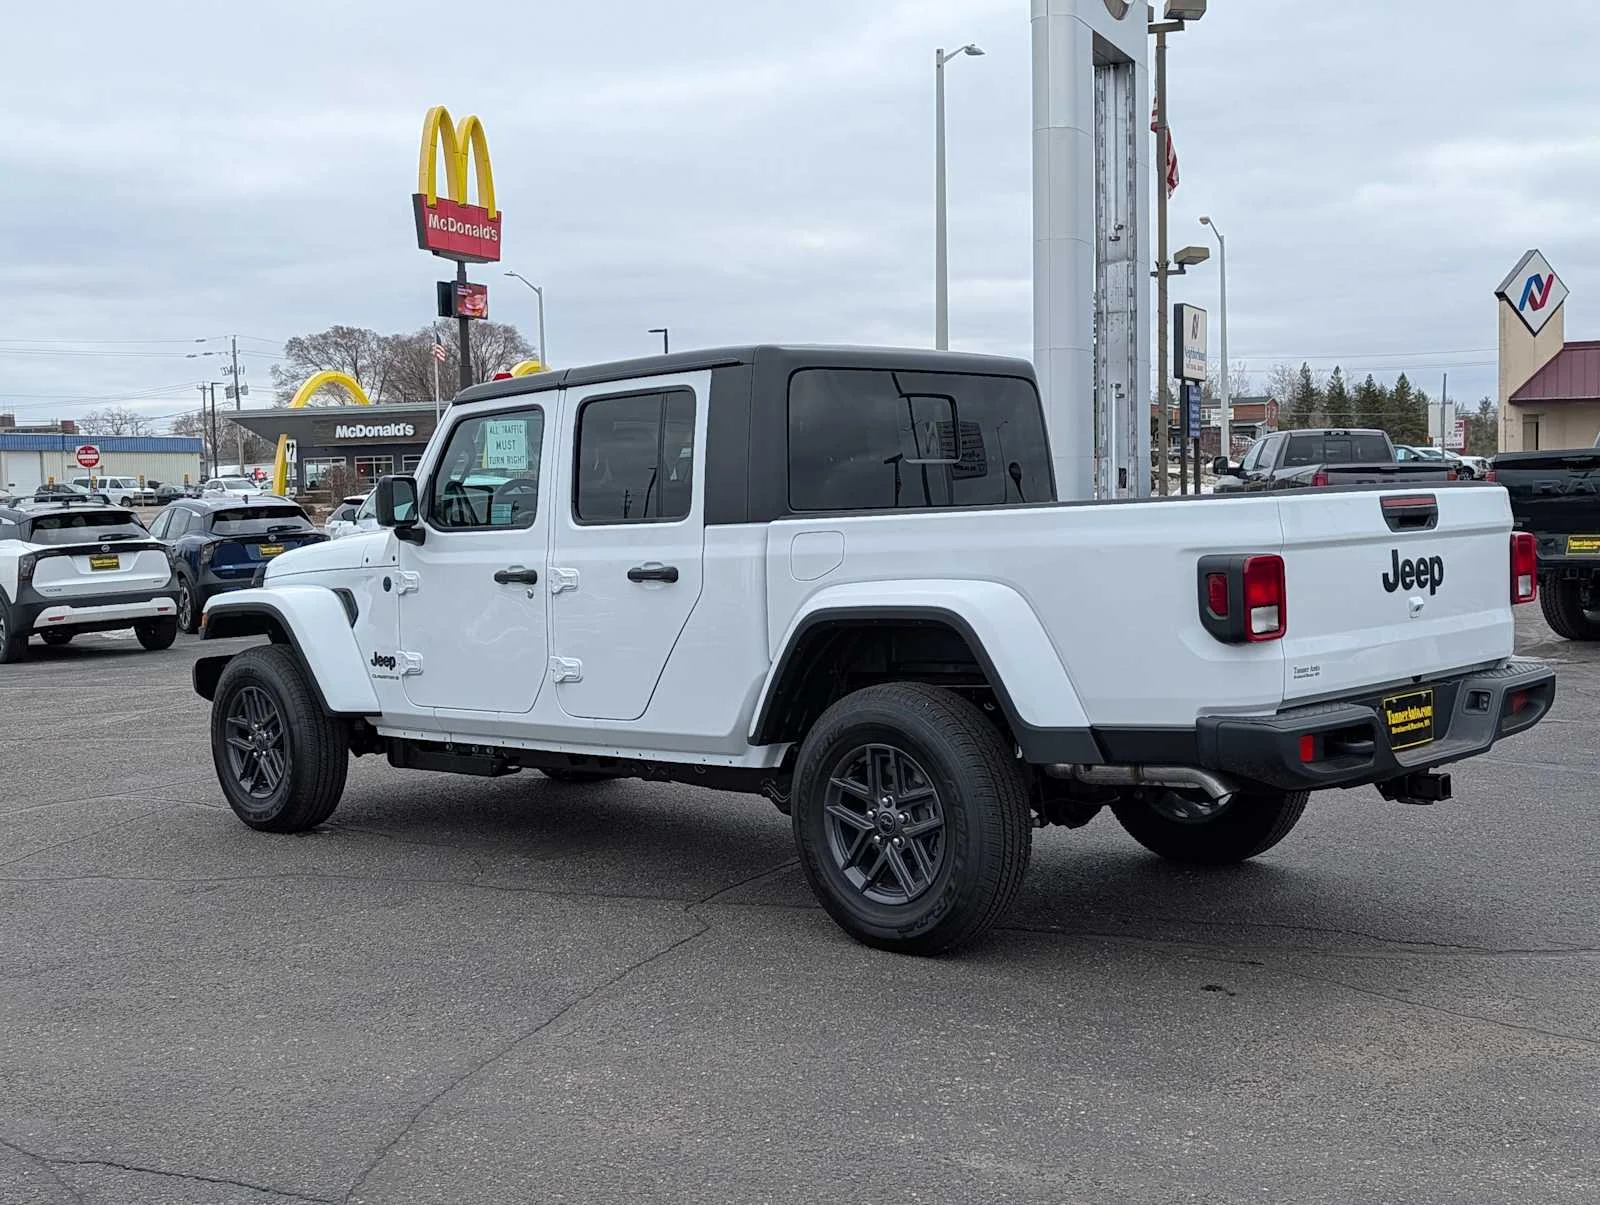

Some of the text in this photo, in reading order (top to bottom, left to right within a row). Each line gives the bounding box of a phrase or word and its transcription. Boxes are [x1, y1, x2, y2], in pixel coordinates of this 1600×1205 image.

[428, 213, 498, 241] McDonald's
[335, 423, 415, 438] McDonald's
[495, 440, 515, 450] MUST
[489, 455, 525, 465] TURN RIGHT
[1532, 480, 1600, 494] RA
[1382, 549, 1444, 596] Jeep
[370, 651, 396, 671] Jeep
